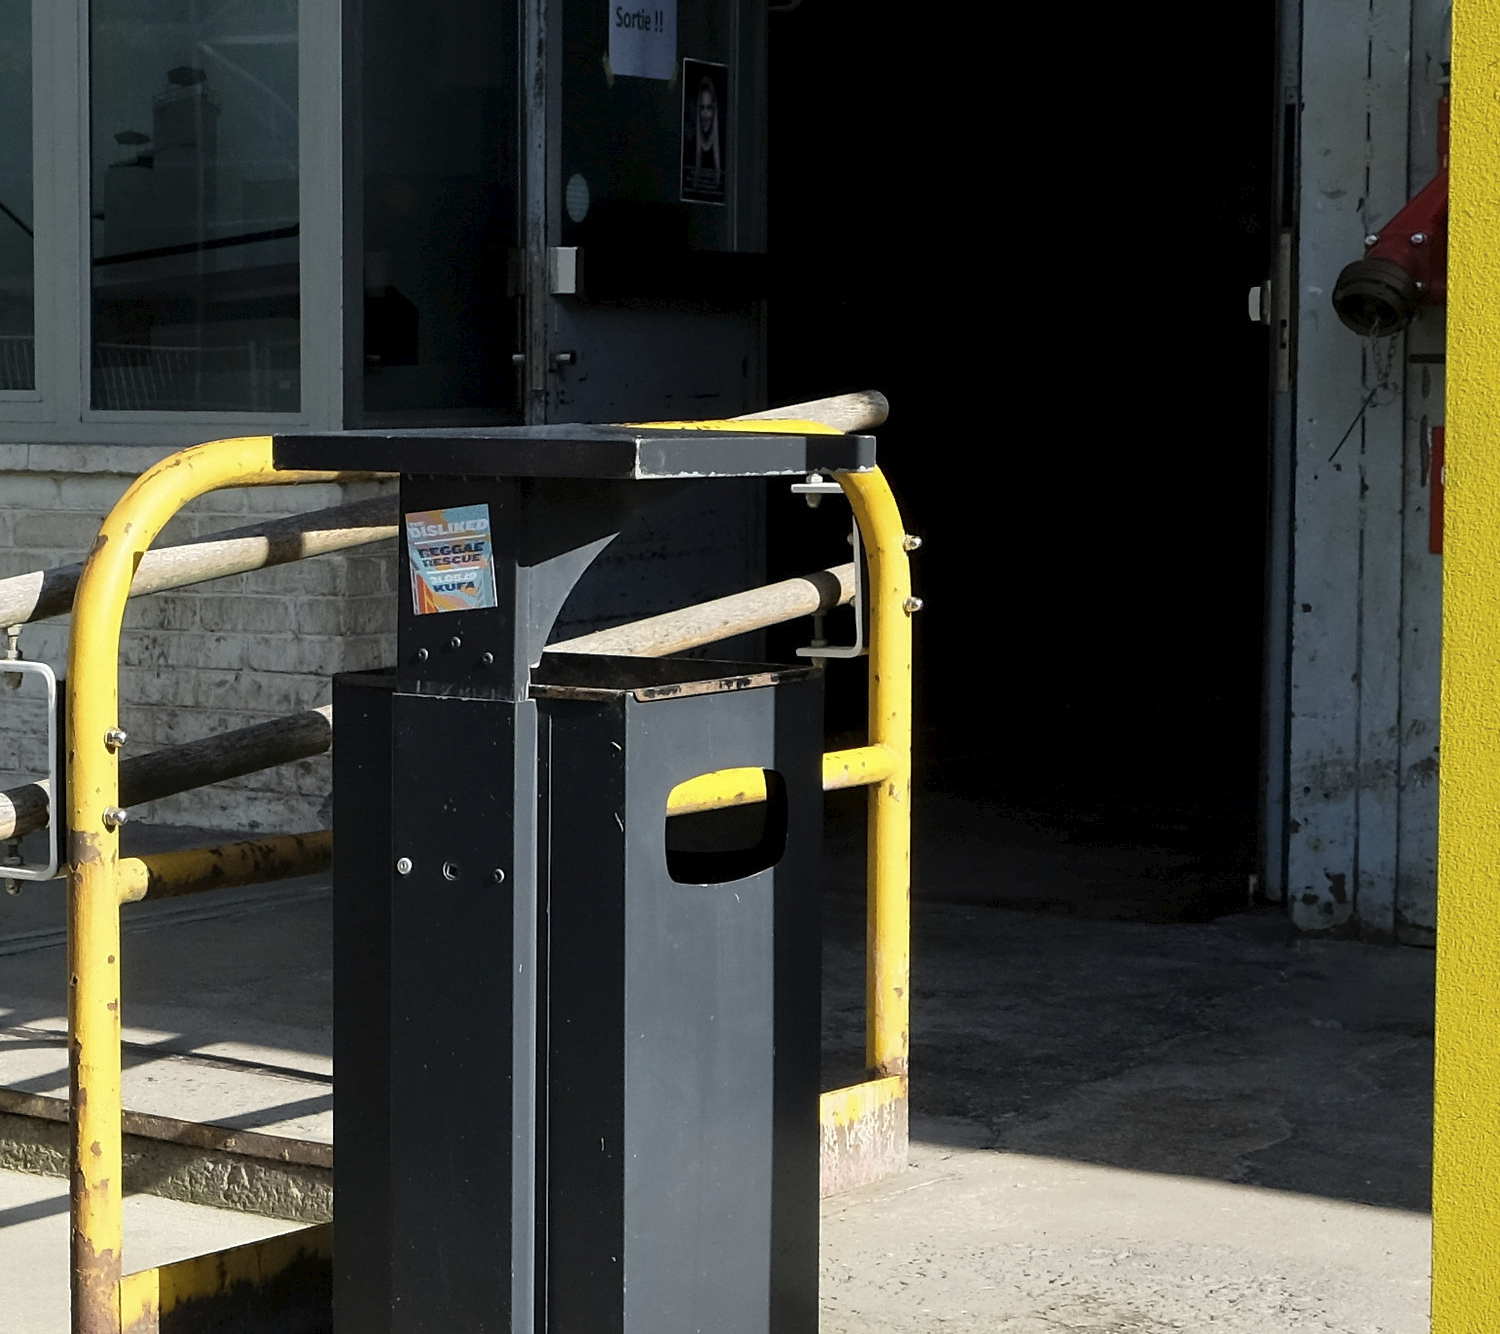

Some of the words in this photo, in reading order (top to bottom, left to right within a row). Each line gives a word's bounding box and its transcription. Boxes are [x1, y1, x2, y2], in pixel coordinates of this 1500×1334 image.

[615, 5, 651, 31] Sortie
[409, 518, 488, 538] DISLIKED
[418, 542, 485, 558] REGGAE
[421, 553, 482, 567] RESCUE
